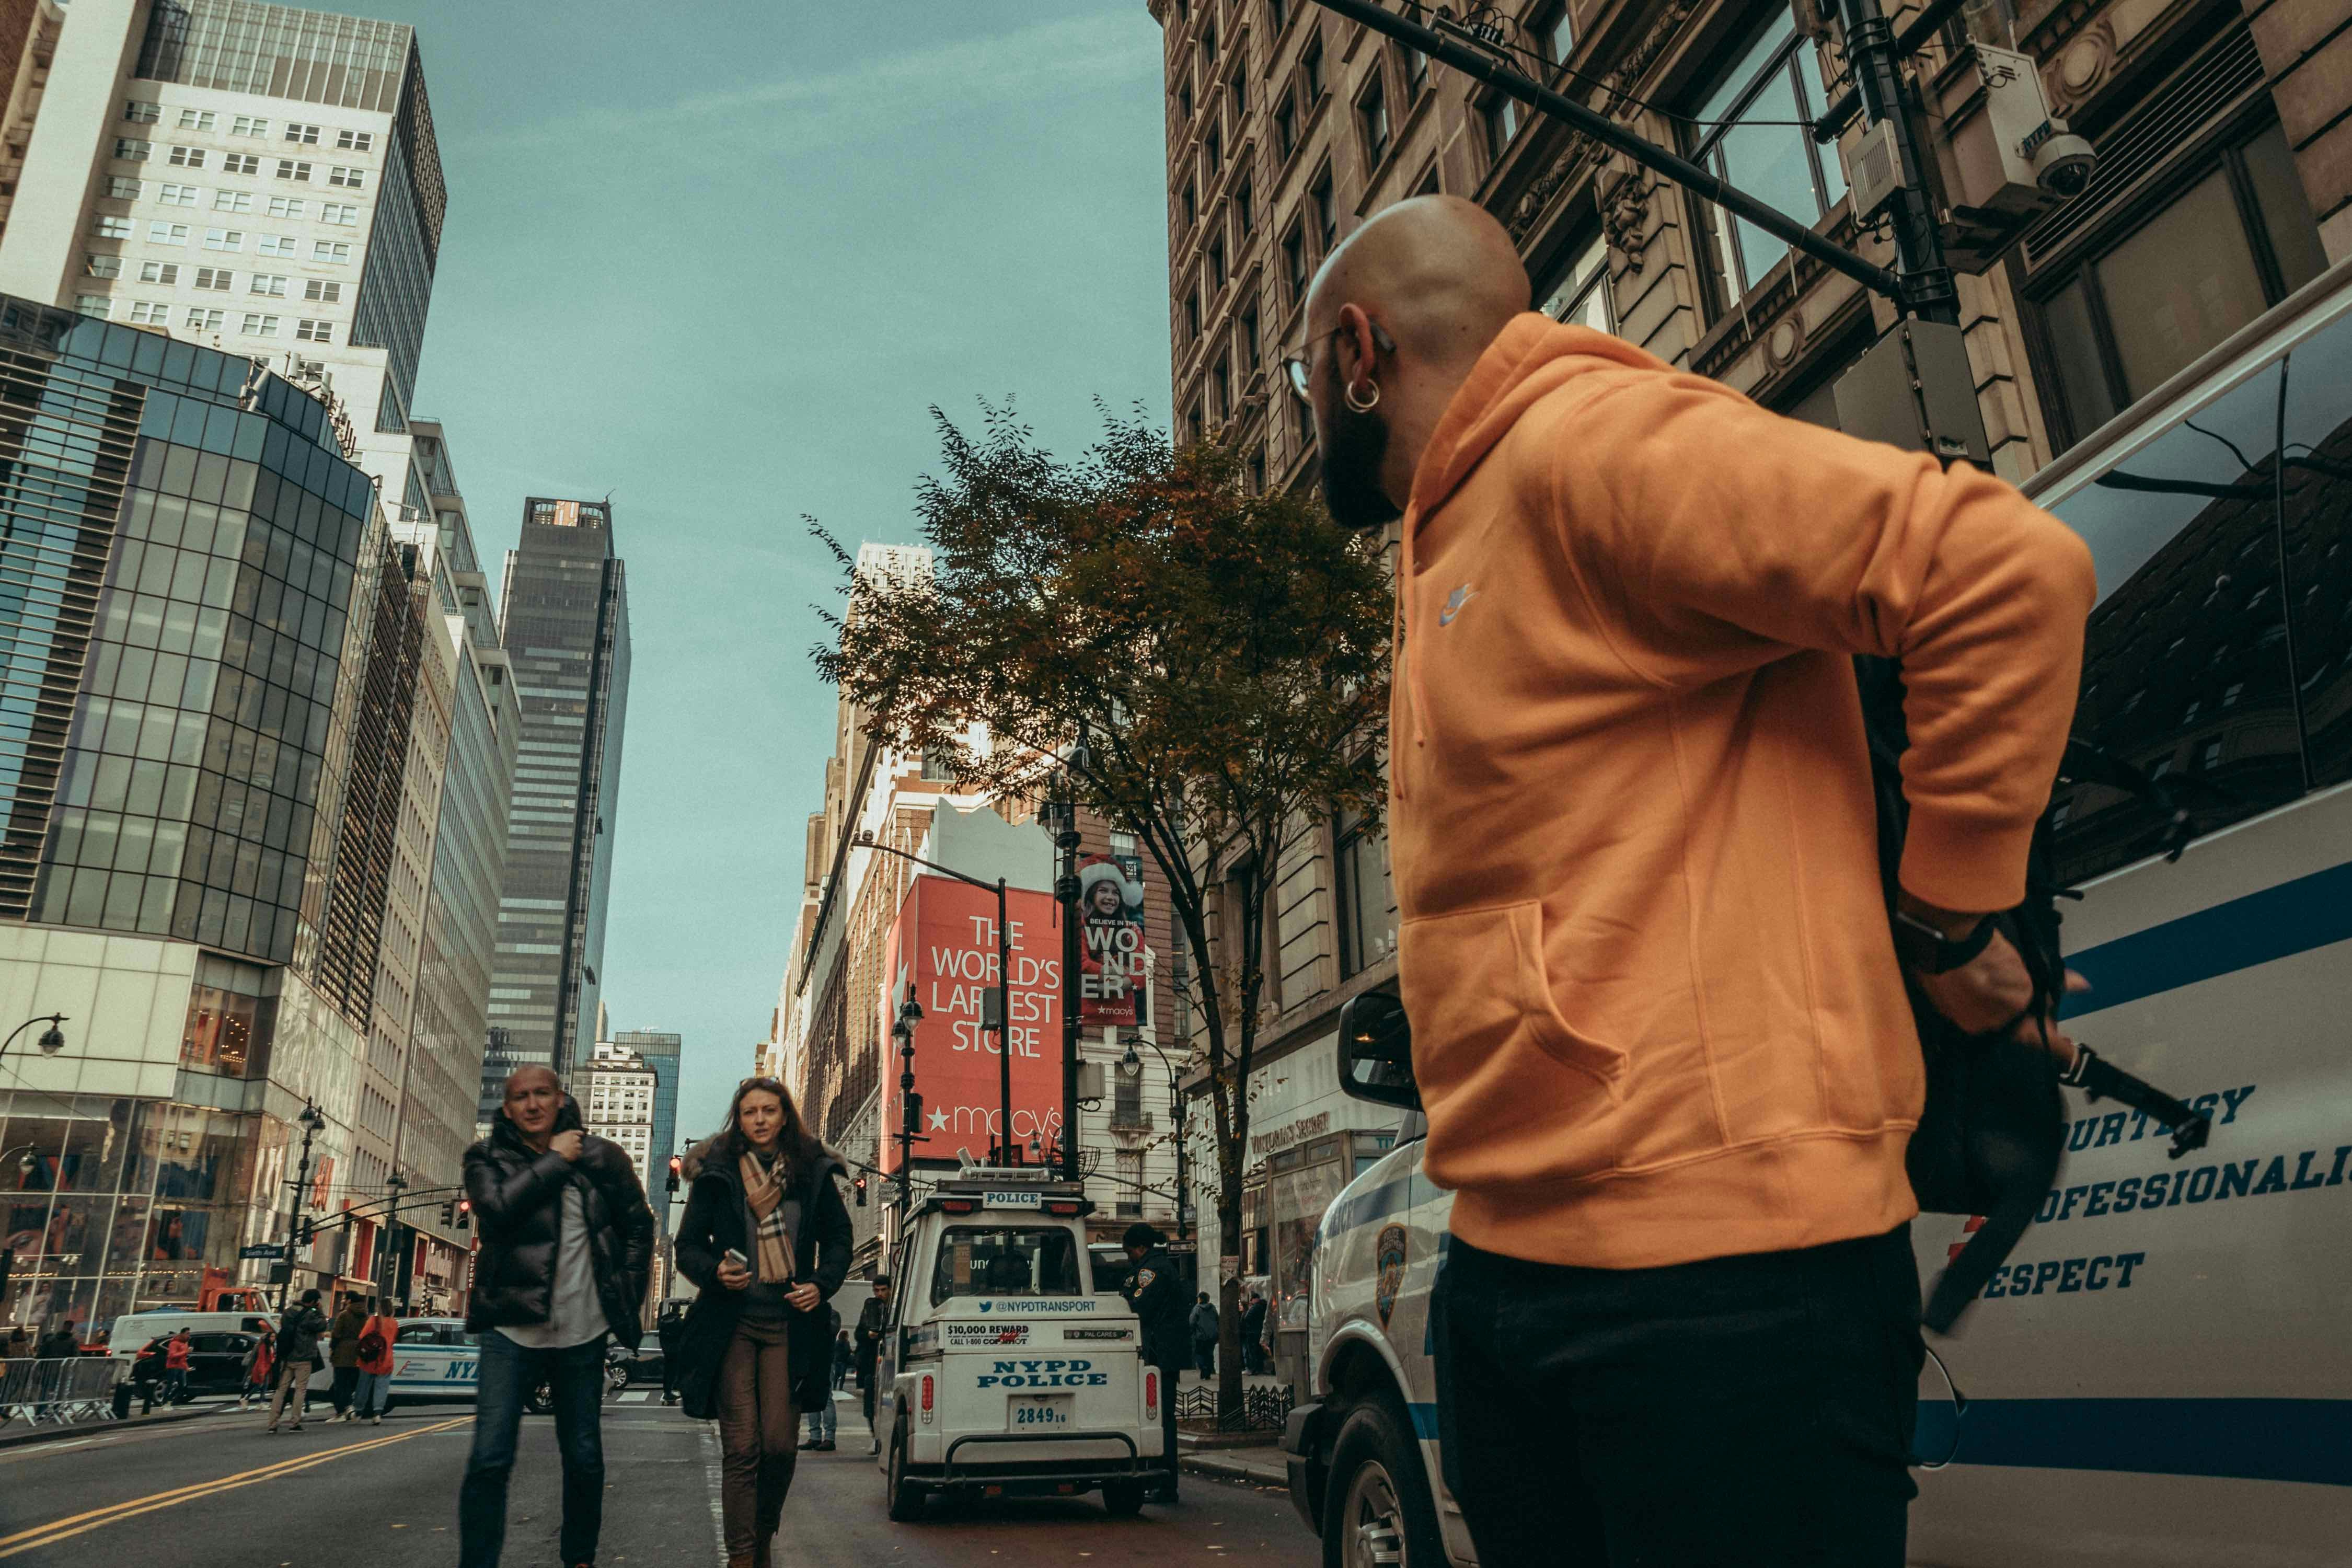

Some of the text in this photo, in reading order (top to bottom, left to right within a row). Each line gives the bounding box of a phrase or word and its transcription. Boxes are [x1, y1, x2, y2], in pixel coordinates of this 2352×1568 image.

[2022, 120, 2050, 152] NYPD
[969, 915, 1024, 951] THE
[1085, 926, 1138, 952] WO
[1103, 951, 1146, 976] ND
[1081, 974, 1124, 999] ER
[932, 981, 1058, 1023] LAREST
[1106, 1006, 1133, 1017] macy's
[2061, 1084, 2256, 1152] URTSY
[2034, 1145, 2352, 1224] OFESSIONALI
[987, 1193, 1038, 1203] POLICE
[1984, 1251, 2146, 1299] ESPECT
[996, 1301, 1096, 1312] @NYPDTRANSPORT
[948, 1324, 1029, 1335] $10,000 REWARD
[444, 1361, 478, 1379] NY
[994, 1360, 1091, 1374] NYPD
[977, 1374, 1108, 1388] POLICE
[1018, 1407, 1066, 1424] 2849 16
